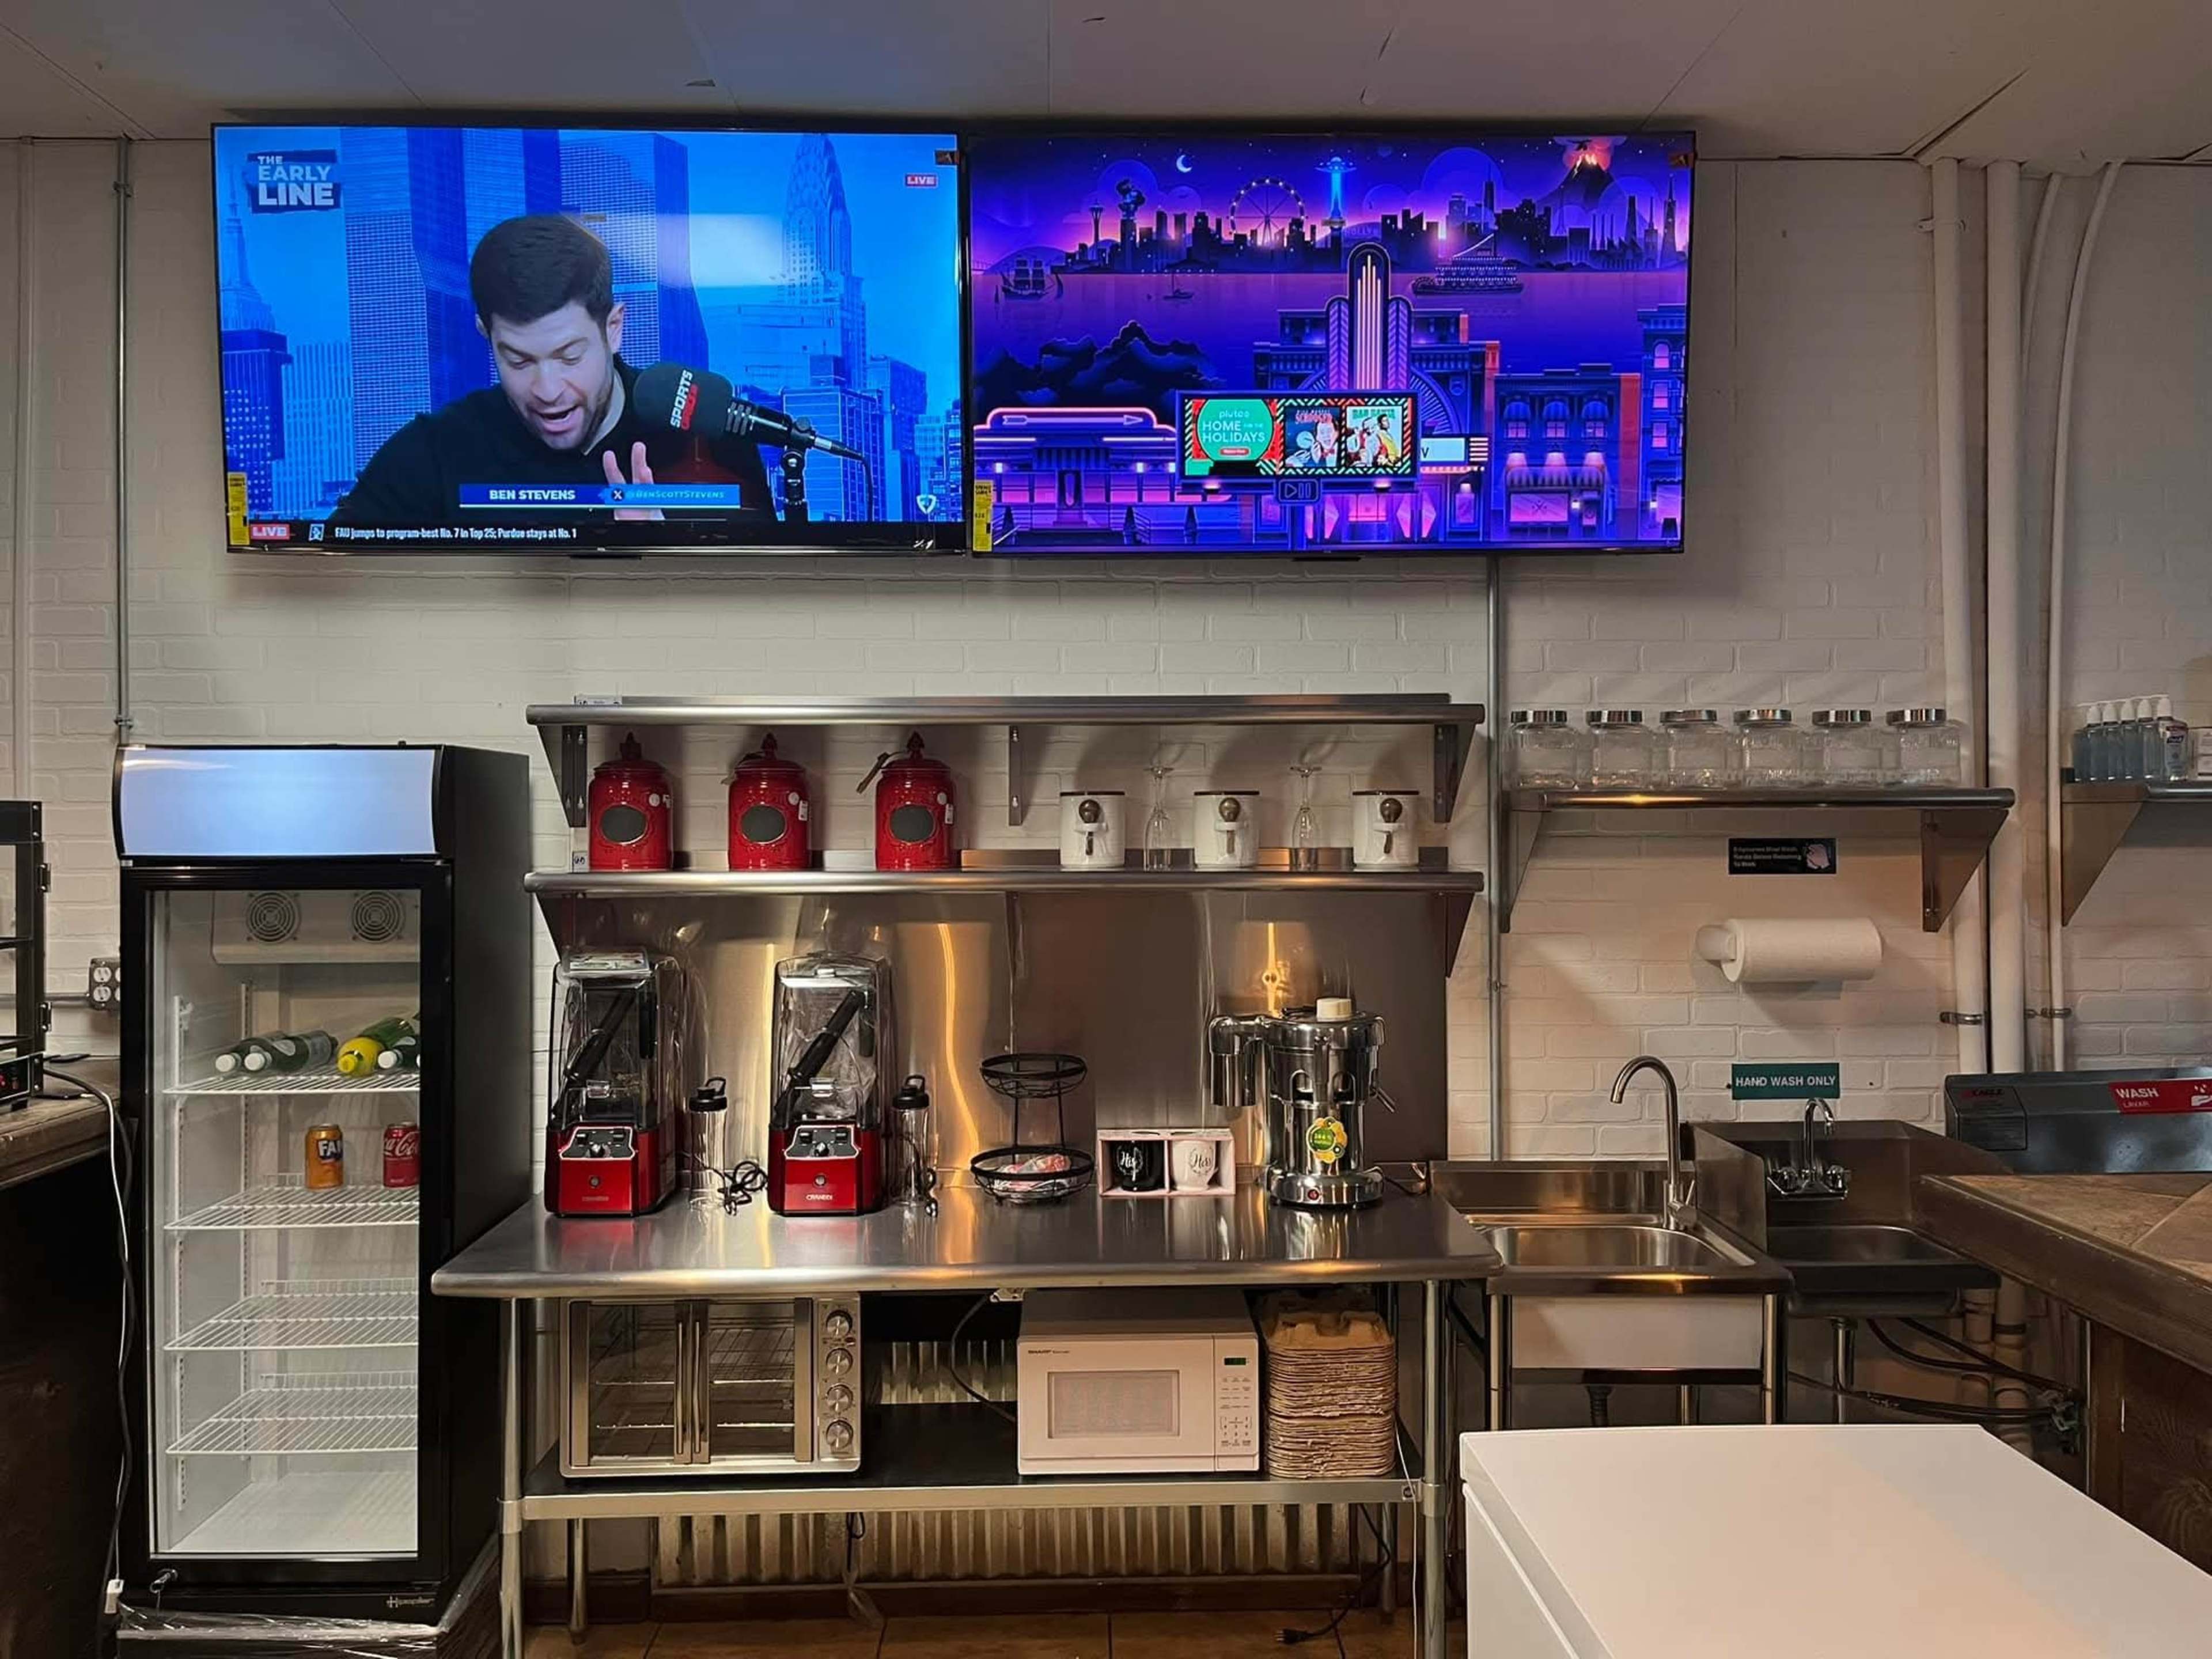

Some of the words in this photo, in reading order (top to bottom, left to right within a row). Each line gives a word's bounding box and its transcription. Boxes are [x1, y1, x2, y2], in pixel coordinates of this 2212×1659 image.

[257, 156, 283, 165] THE
[259, 165, 331, 181] EARLY
[907, 176, 935, 185] LIVE
[259, 182, 334, 206] LINE
[670, 369, 693, 428] SPORTS
[1202, 421, 1241, 431] HOME
[1202, 432, 1265, 442] HOLIDAYS
[490, 490, 516, 500] BEN
[518, 490, 575, 500] STEVENS
[252, 527, 287, 536] LIVE
[335, 527, 350, 537] FAU
[351, 528, 375, 539] jumps
[376, 528, 385, 537] to
[386, 528, 439, 540] program-best
[440, 528, 453, 537] No.
[454, 528, 460, 537] 7
[460, 528, 468, 537] in
[469, 528, 483, 540] Top
[498, 528, 525, 538] Purdue
[526, 528, 547, 540] stays
[548, 528, 557, 538] at
[558, 528, 570, 538] No.
[572, 528, 577, 538] 1
[1735, 1077, 1767, 1087] HAND
[1770, 1076, 1804, 1086] WASH
[1806, 1075, 1835, 1086] ONLY
[2115, 1088, 2160, 1099] WASH
